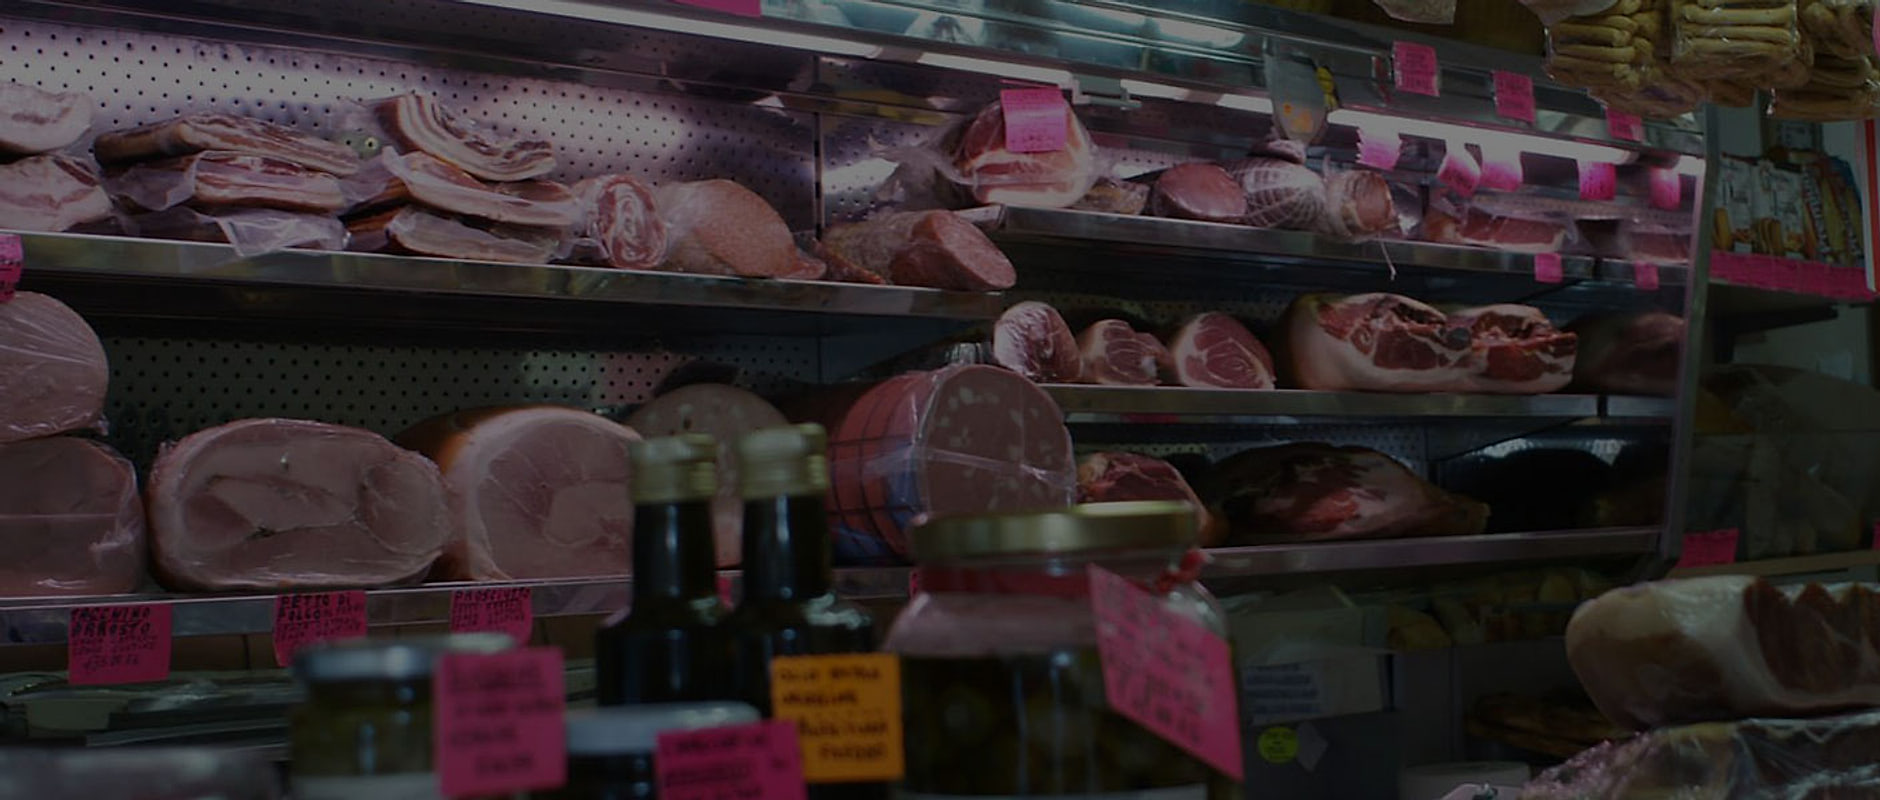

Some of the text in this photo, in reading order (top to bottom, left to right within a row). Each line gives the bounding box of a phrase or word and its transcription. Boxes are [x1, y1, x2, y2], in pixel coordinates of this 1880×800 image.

[281, 594, 329, 608] PETTO
[278, 608, 320, 622] POLLO
[71, 621, 151, 637] ARROSTO
